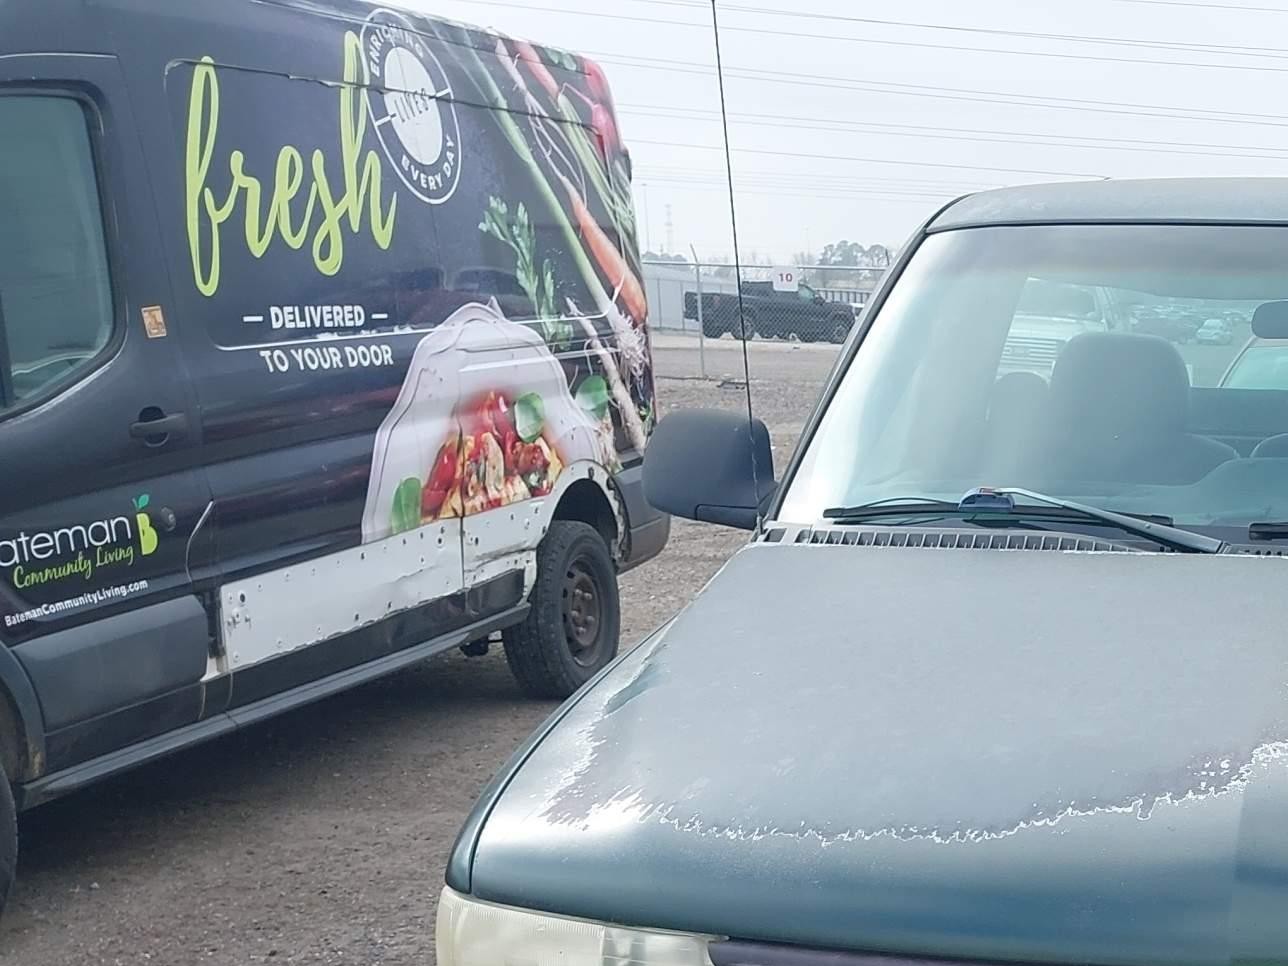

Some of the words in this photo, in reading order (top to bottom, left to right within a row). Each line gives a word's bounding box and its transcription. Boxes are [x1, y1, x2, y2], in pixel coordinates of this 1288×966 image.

[186, 30, 397, 297] fresh
[401, 154, 444, 190] EVERY
[443, 135, 455, 178] DAY
[779, 272, 793, 283] 10
[269, 304, 365, 329] DELIVERED
[259, 349, 289, 373] TO
[290, 346, 344, 371] YOUR
[343, 344, 394, 368] DOOR
[13, 551, 92, 589] Community
[95, 546, 134, 567] Living
[4, 579, 149, 627] BatemanCommunityLiving.com
